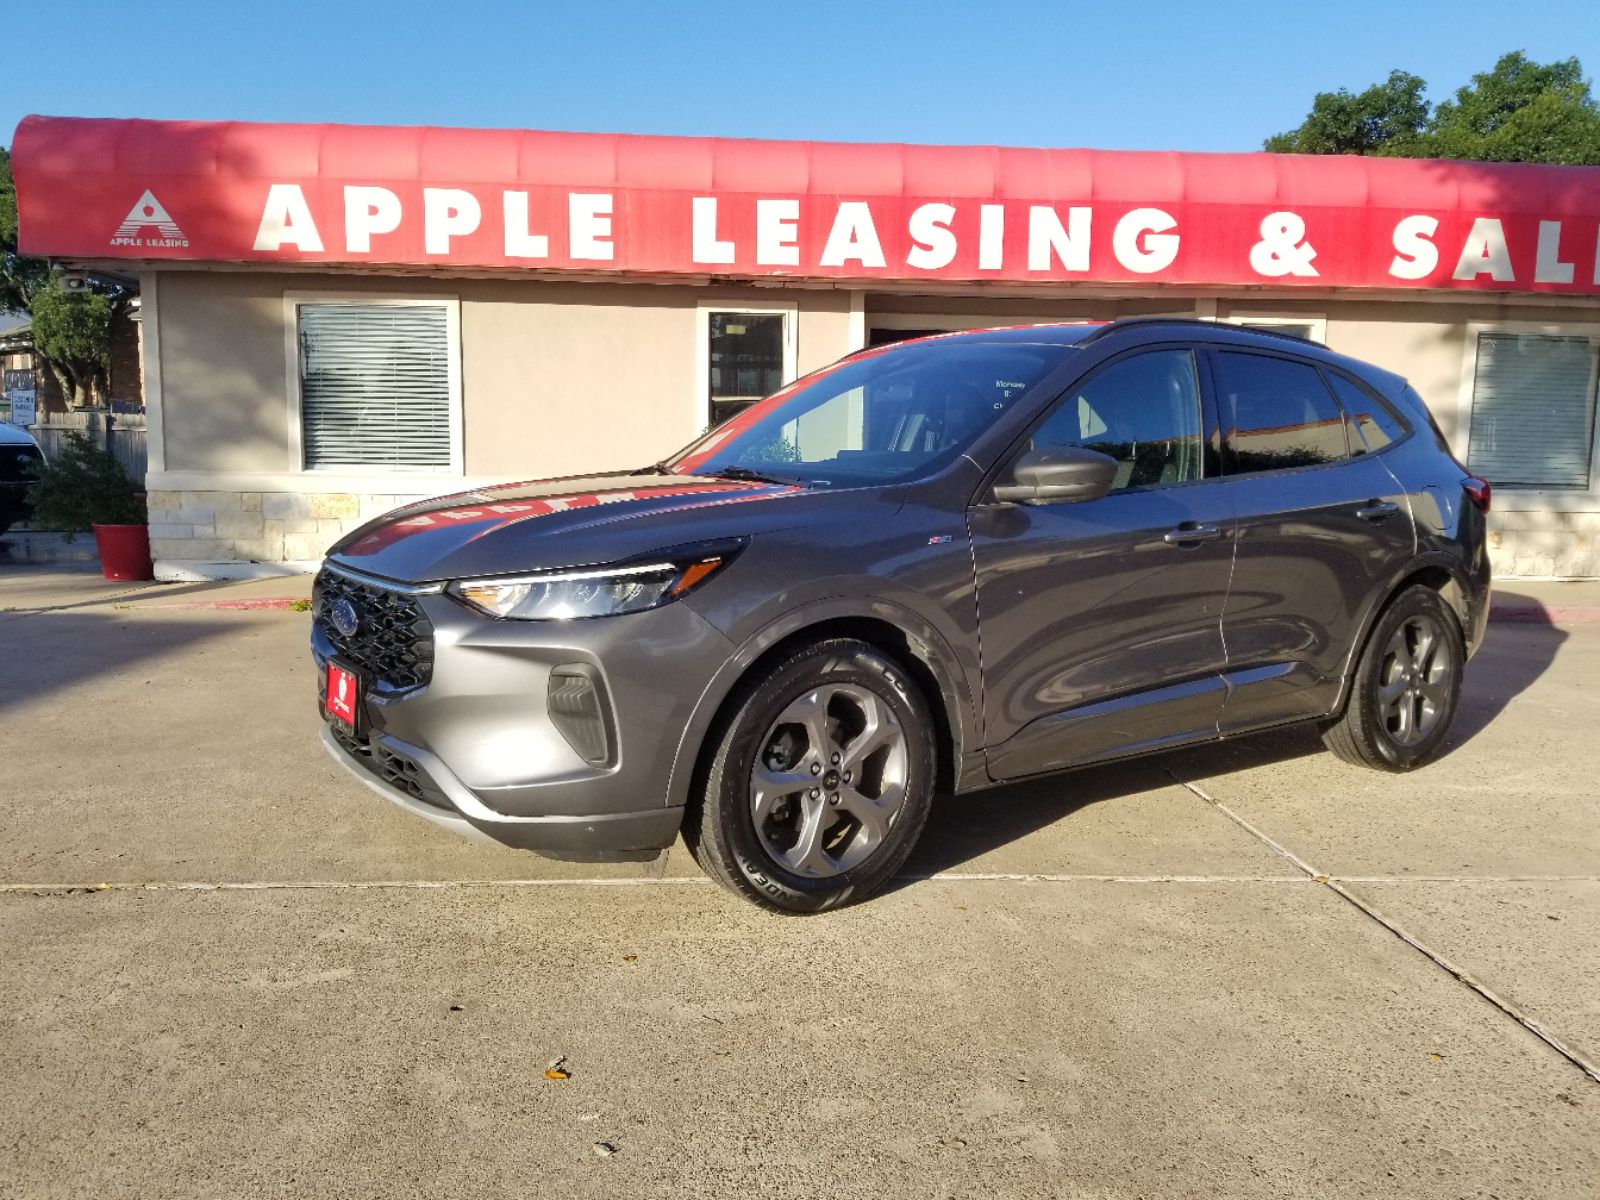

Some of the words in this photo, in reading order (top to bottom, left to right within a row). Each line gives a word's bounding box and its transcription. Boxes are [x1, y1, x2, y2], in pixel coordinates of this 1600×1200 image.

[110, 238, 143, 247] APPLE
[146, 238, 189, 248] LEASING
[253, 183, 616, 261] APPLE
[692, 196, 1181, 274] LEASING
[1249, 211, 1321, 278] &
[1388, 214, 1600, 285] SAL
